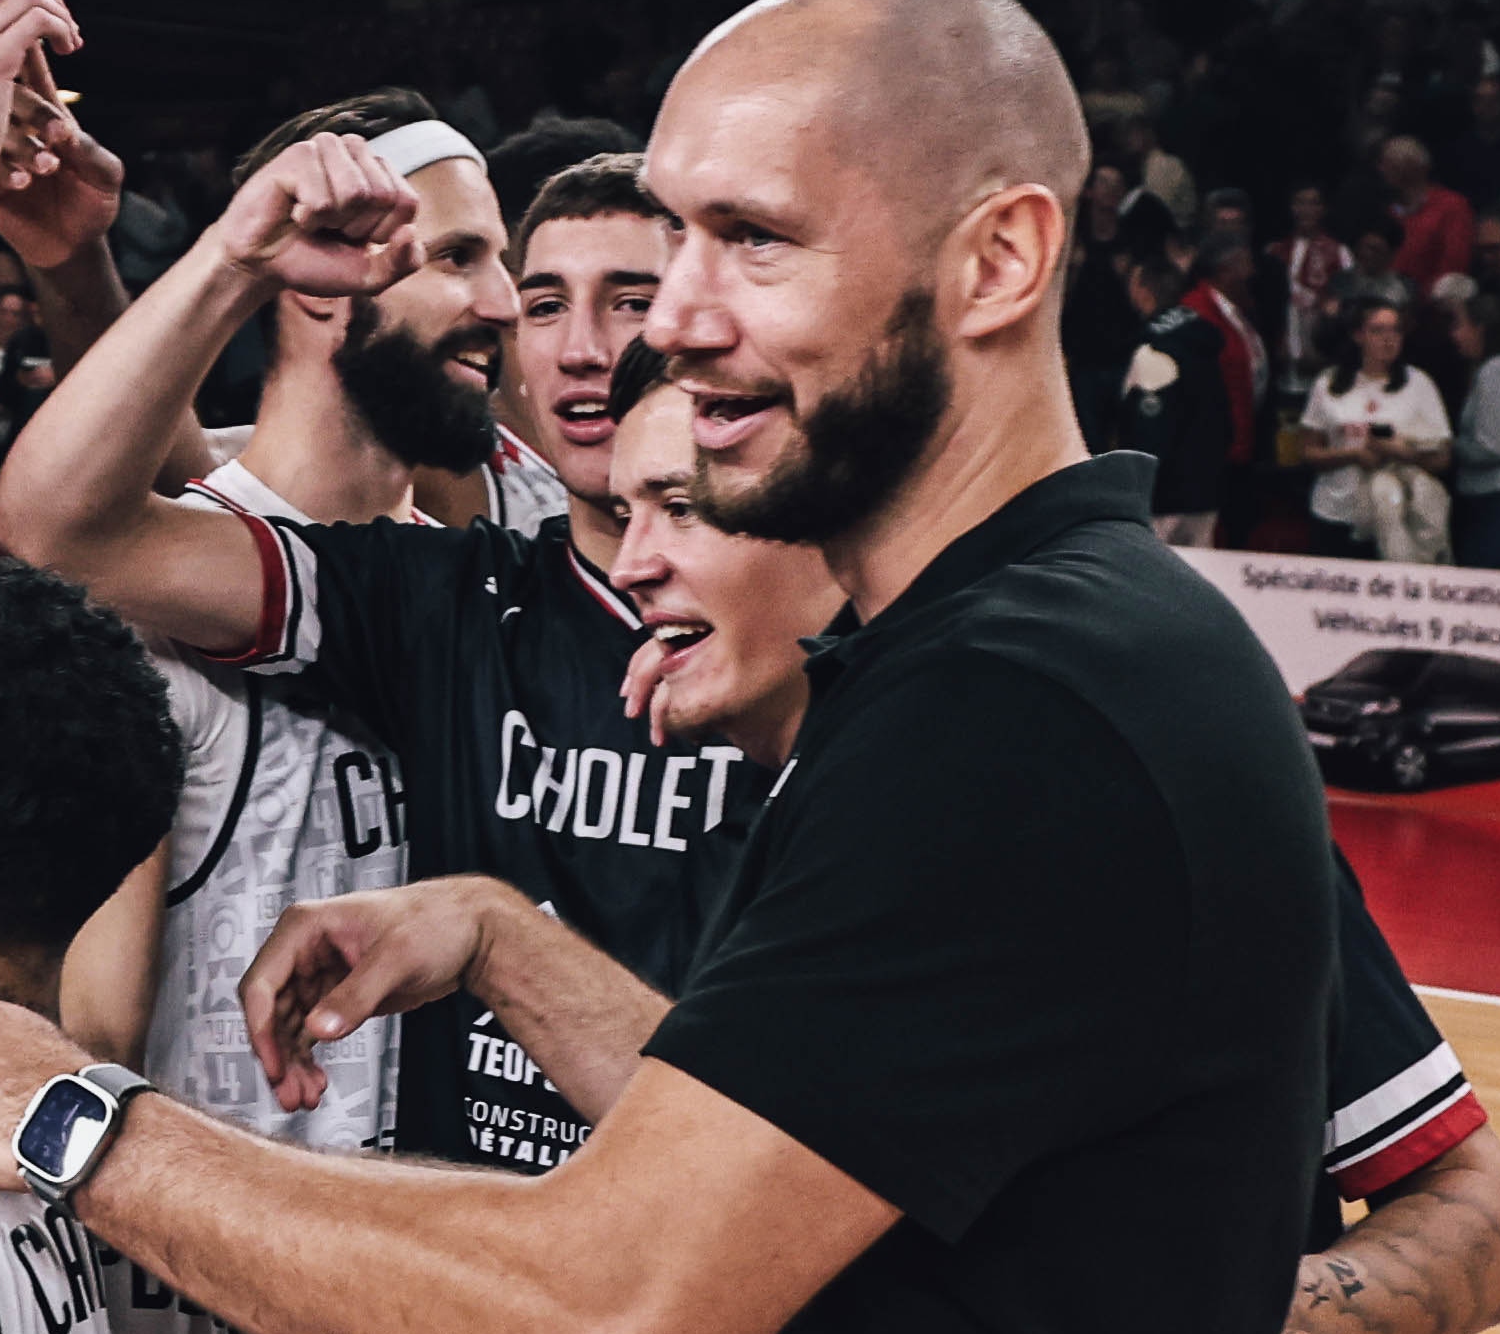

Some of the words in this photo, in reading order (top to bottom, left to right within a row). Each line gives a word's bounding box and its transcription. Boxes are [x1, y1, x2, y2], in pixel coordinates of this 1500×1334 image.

[1240, 562, 1361, 595] Spécialiste
[1368, 574, 1396, 597] de
[1402, 578, 1422, 600] la
[1312, 607, 1421, 640] Véhicules
[1428, 617, 1443, 641] 9
[495, 709, 745, 853] CHOLET
